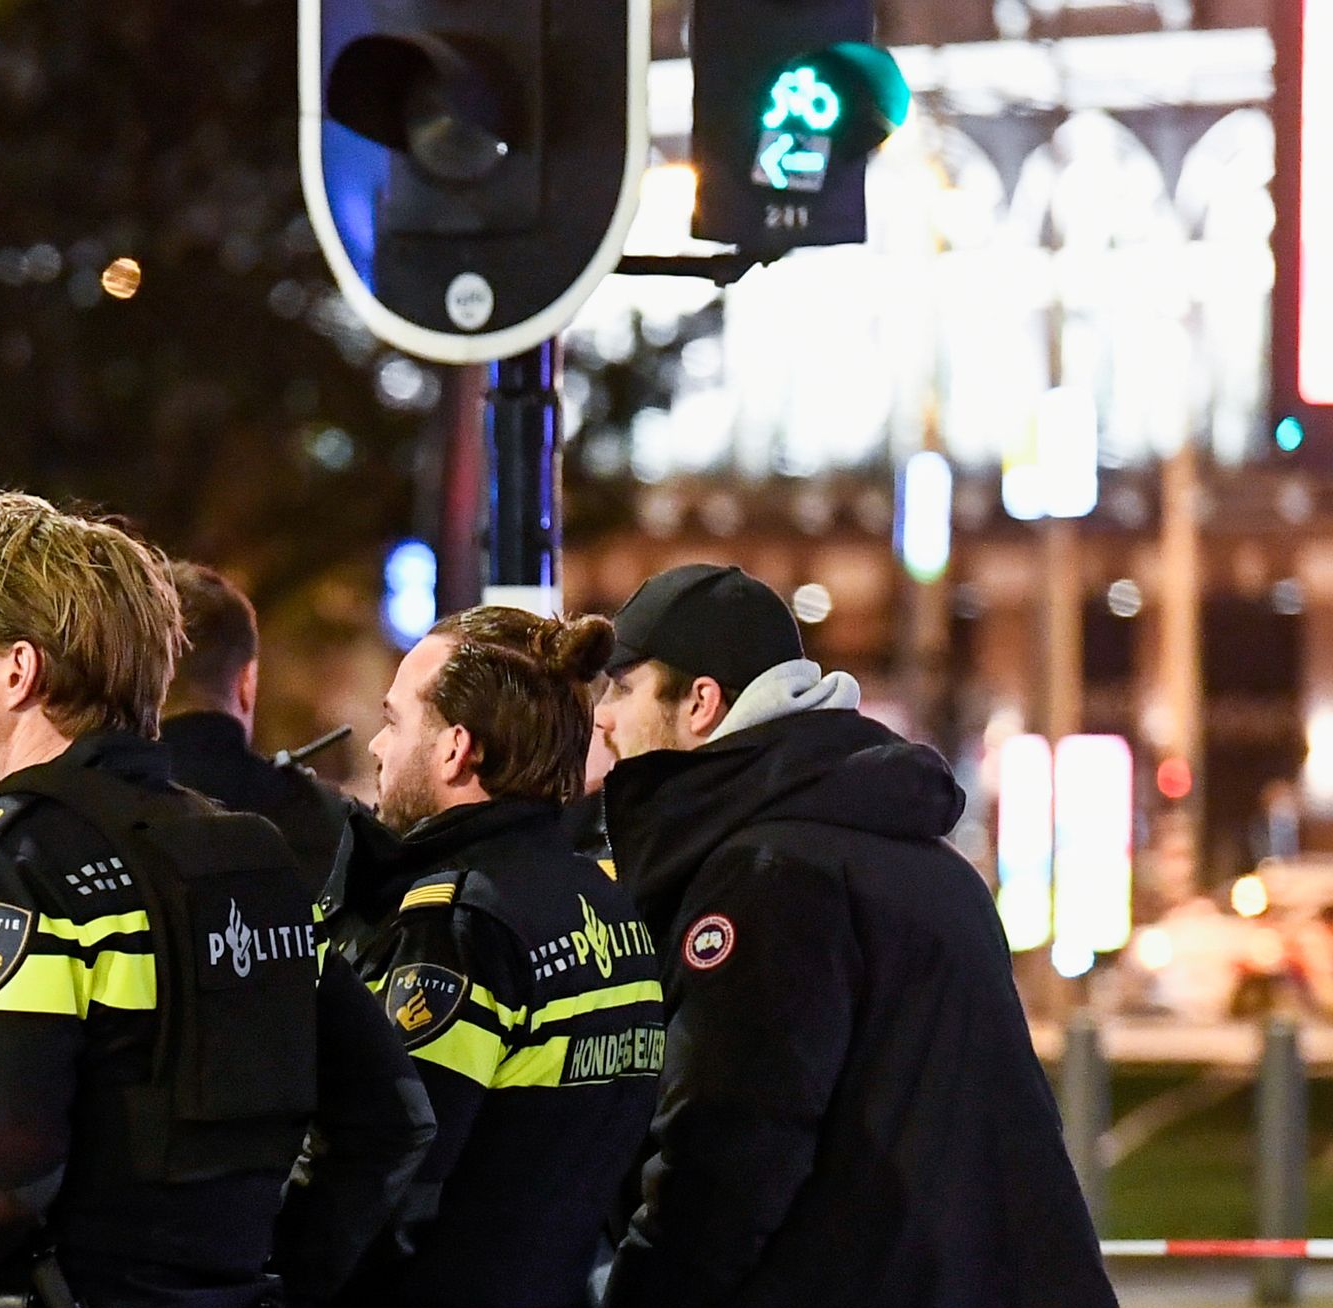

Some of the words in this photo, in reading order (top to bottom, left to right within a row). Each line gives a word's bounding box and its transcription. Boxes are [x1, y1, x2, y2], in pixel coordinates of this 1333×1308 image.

[209, 923, 317, 978] POLITIE
[570, 921, 656, 979] POLITI
[396, 976, 456, 993] POLITIE
